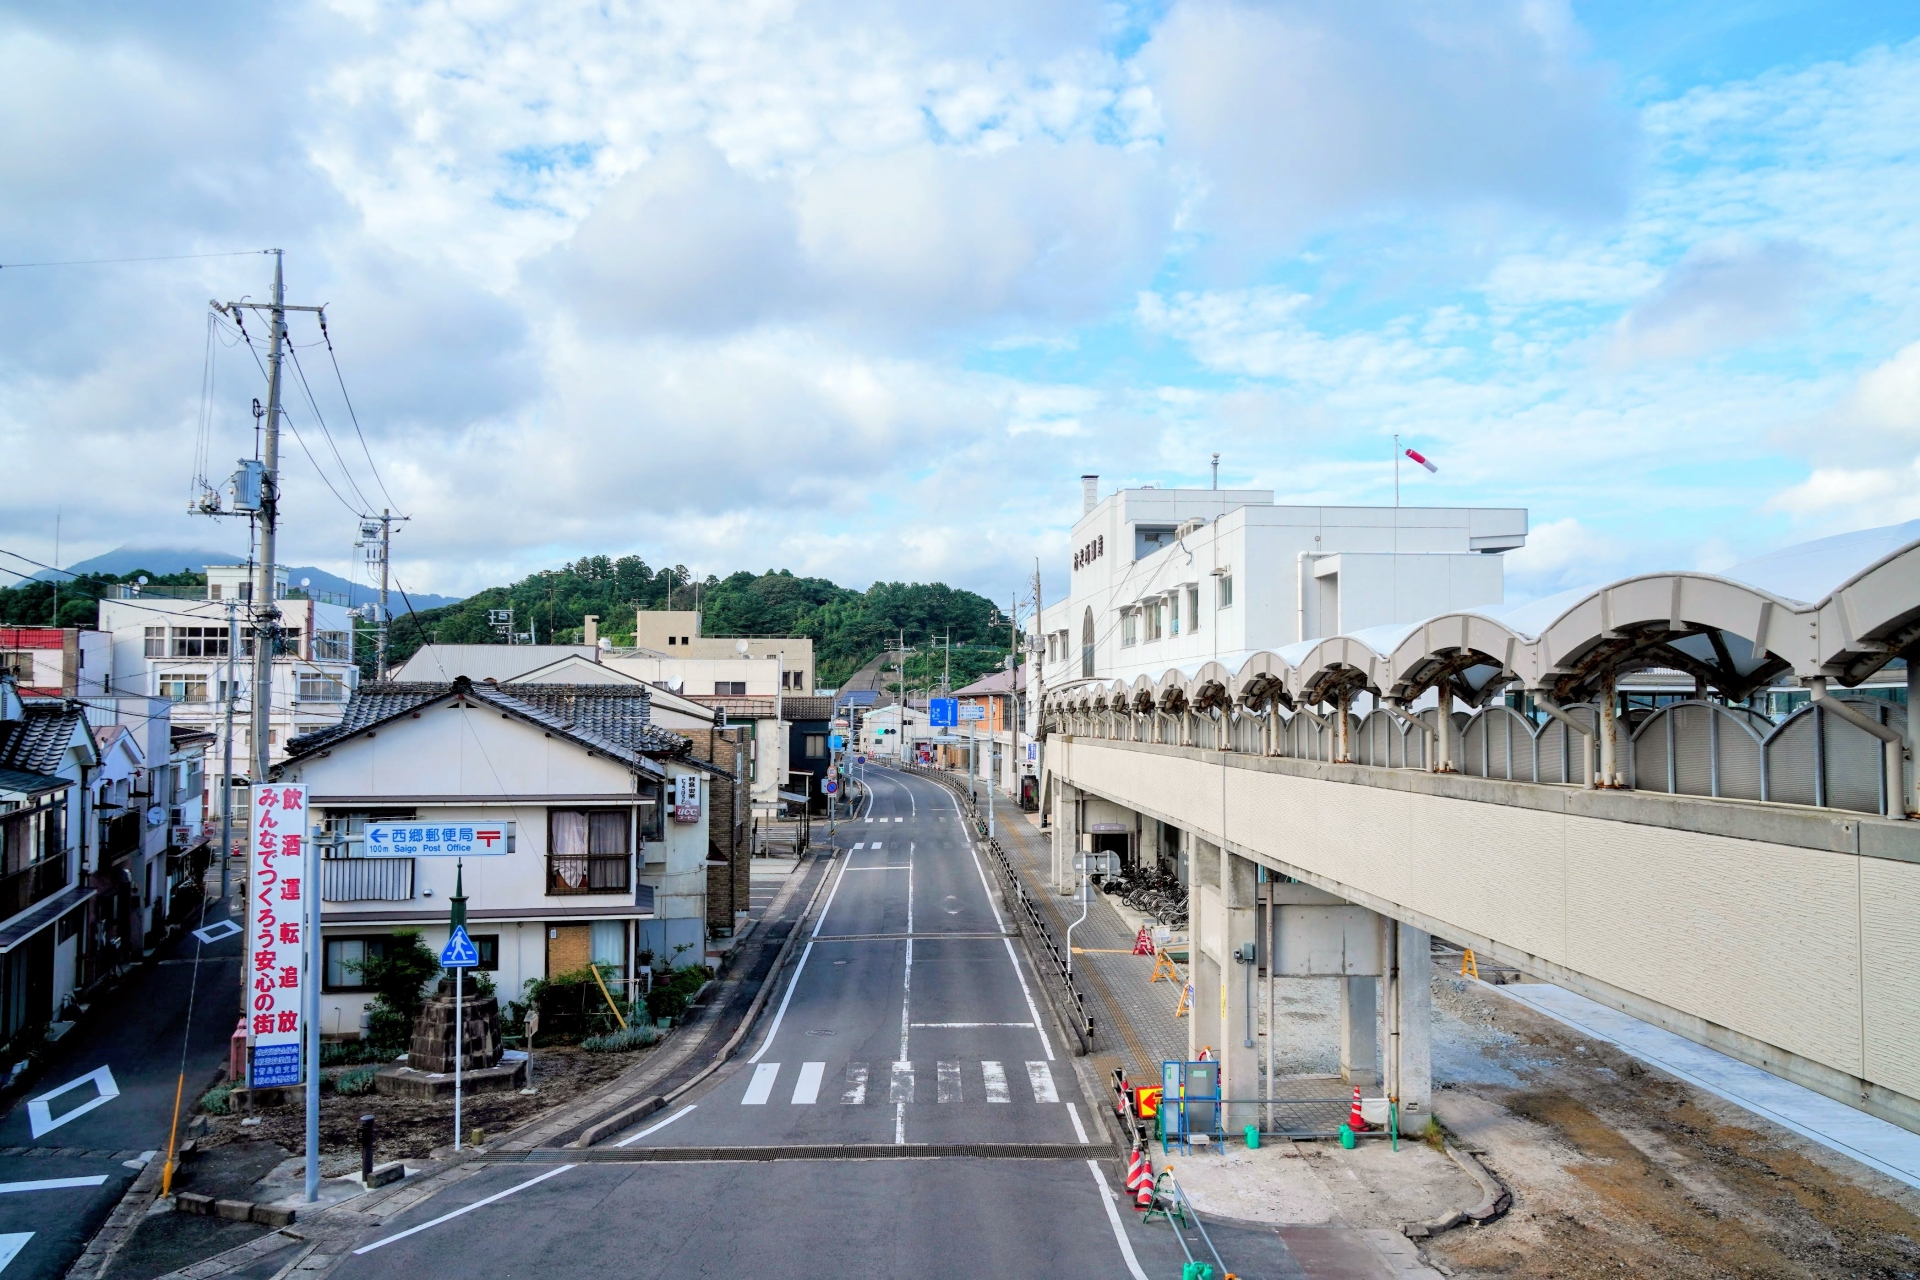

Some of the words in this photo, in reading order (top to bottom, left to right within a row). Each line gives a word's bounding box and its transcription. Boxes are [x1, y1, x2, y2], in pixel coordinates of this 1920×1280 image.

[369, 845, 389, 853] 100m
[394, 844, 417, 854] Saigo
[423, 844, 441, 852] Post
[446, 843, 471, 852] Office
[391, 827, 474, 843] 西郷郵便局
[253, 788, 279, 1034] みんなでつくろう安心の街
[277, 788, 302, 1033] 飲酒運転追放
